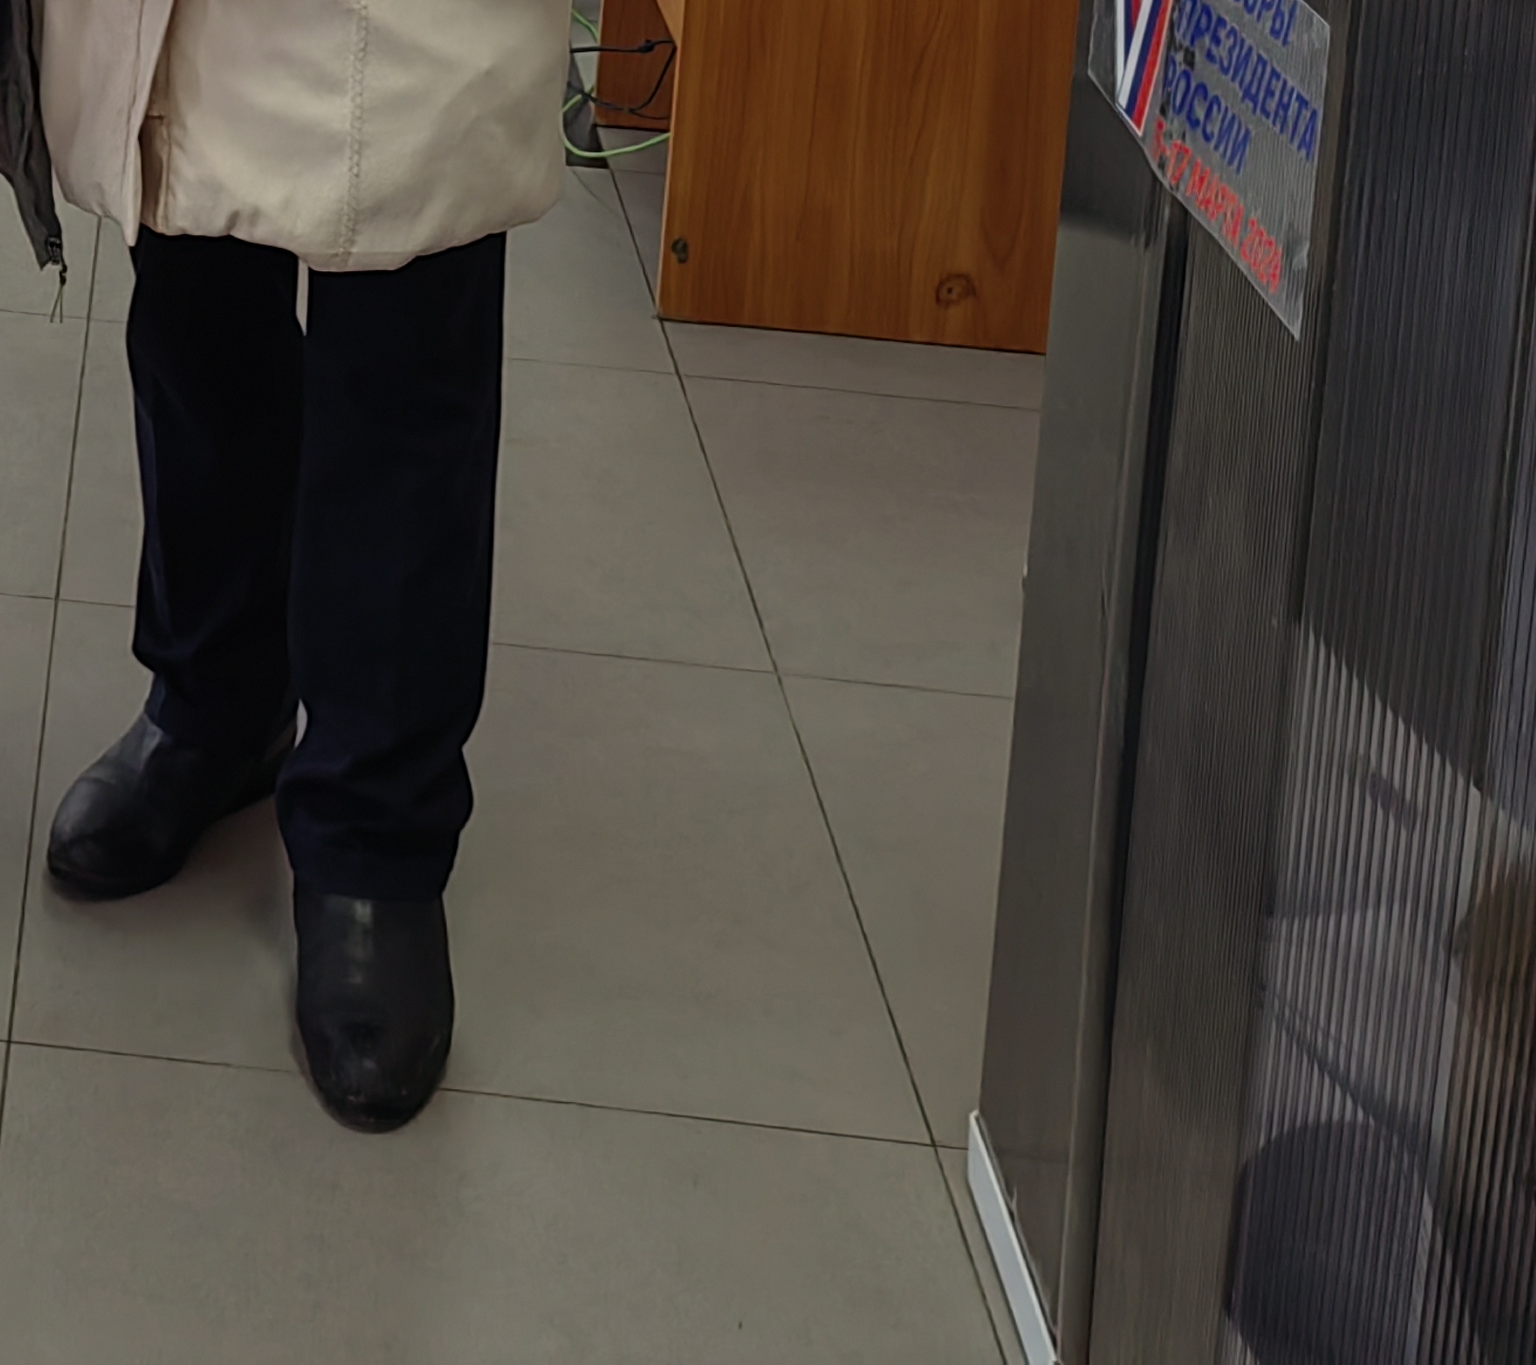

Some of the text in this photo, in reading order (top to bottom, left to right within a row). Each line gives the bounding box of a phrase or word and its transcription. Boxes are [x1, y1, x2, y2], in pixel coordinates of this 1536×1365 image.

[1163, 56, 1253, 175] РОССИИ
[1186, 157, 1245, 248] МАРТА
[1241, 217, 1284, 294] 2024
